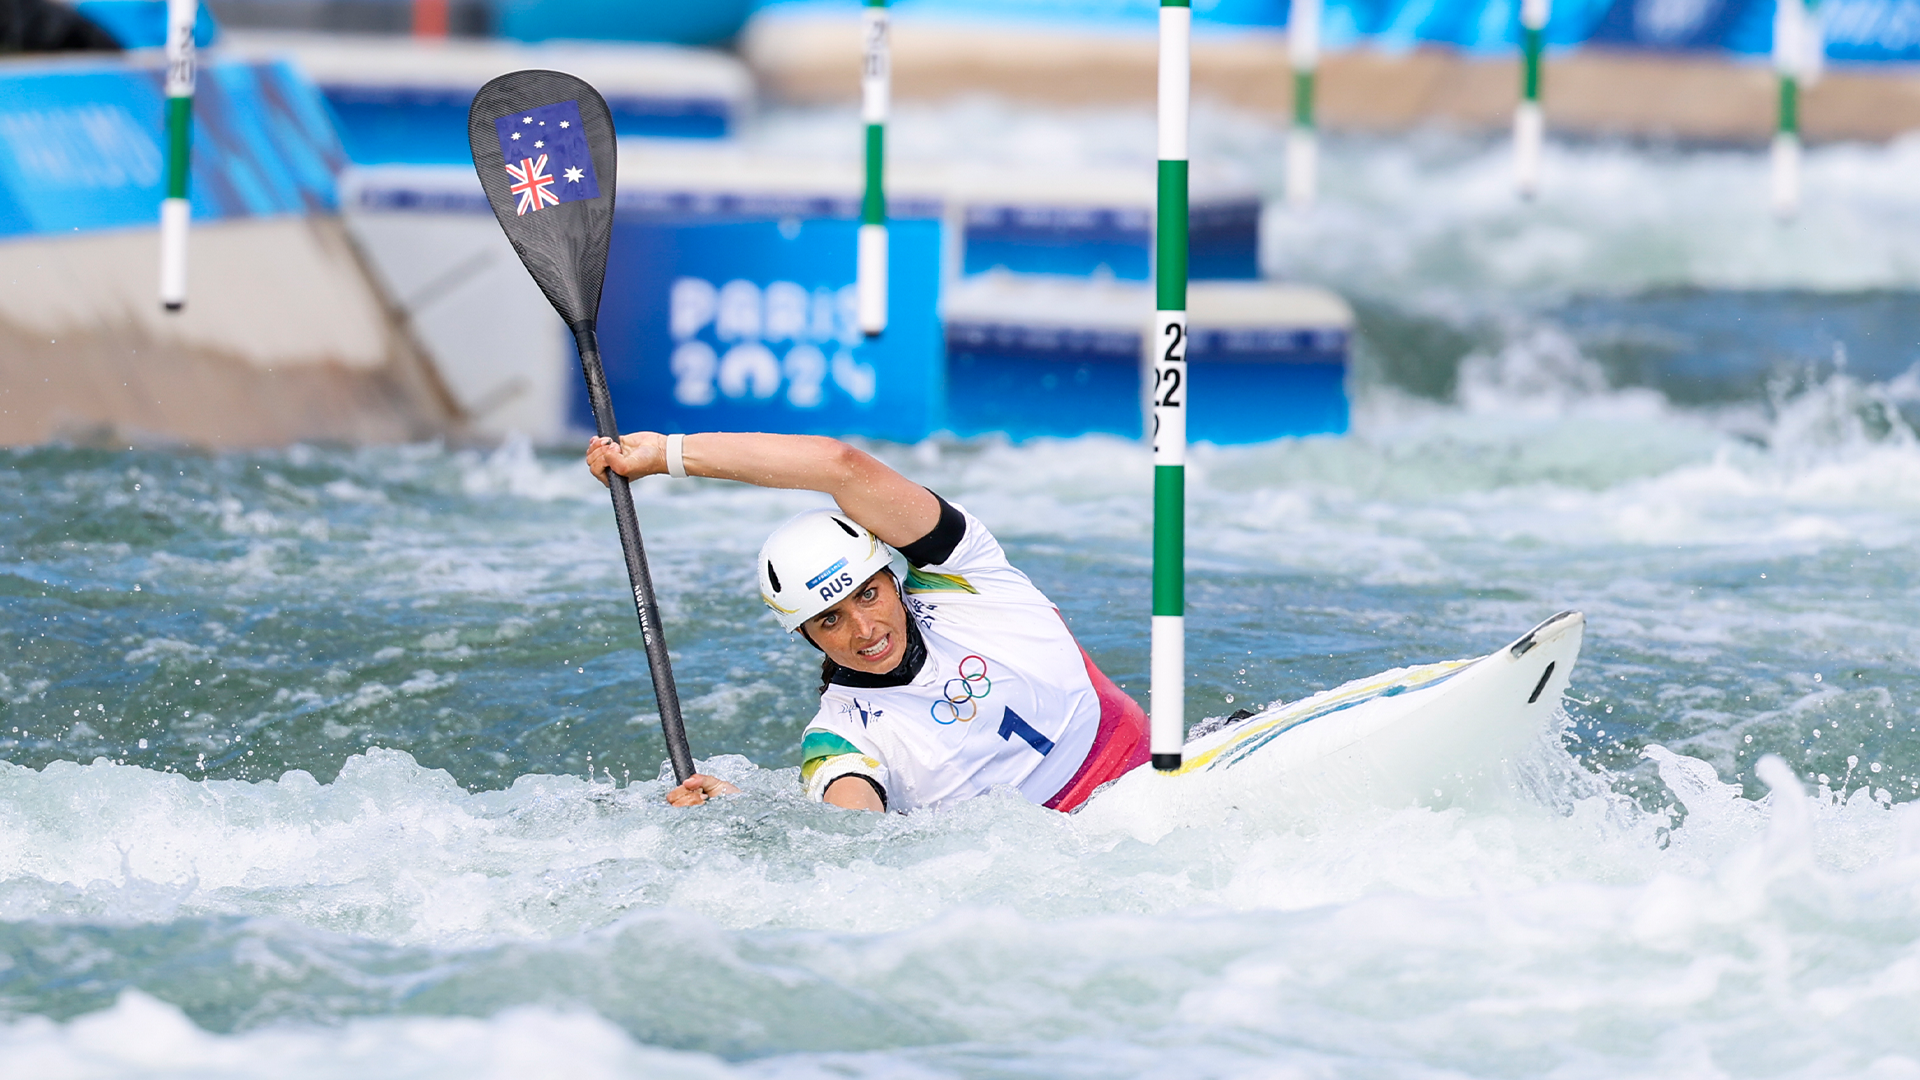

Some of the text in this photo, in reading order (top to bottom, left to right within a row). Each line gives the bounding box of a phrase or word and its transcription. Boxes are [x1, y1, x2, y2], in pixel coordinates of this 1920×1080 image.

[1164, 323, 1187, 362] 2
[671, 340, 876, 407] 2024
[634, 584, 649, 632] PARIS 2024
[819, 572, 853, 602] AUS
[997, 705, 1056, 758] 1
